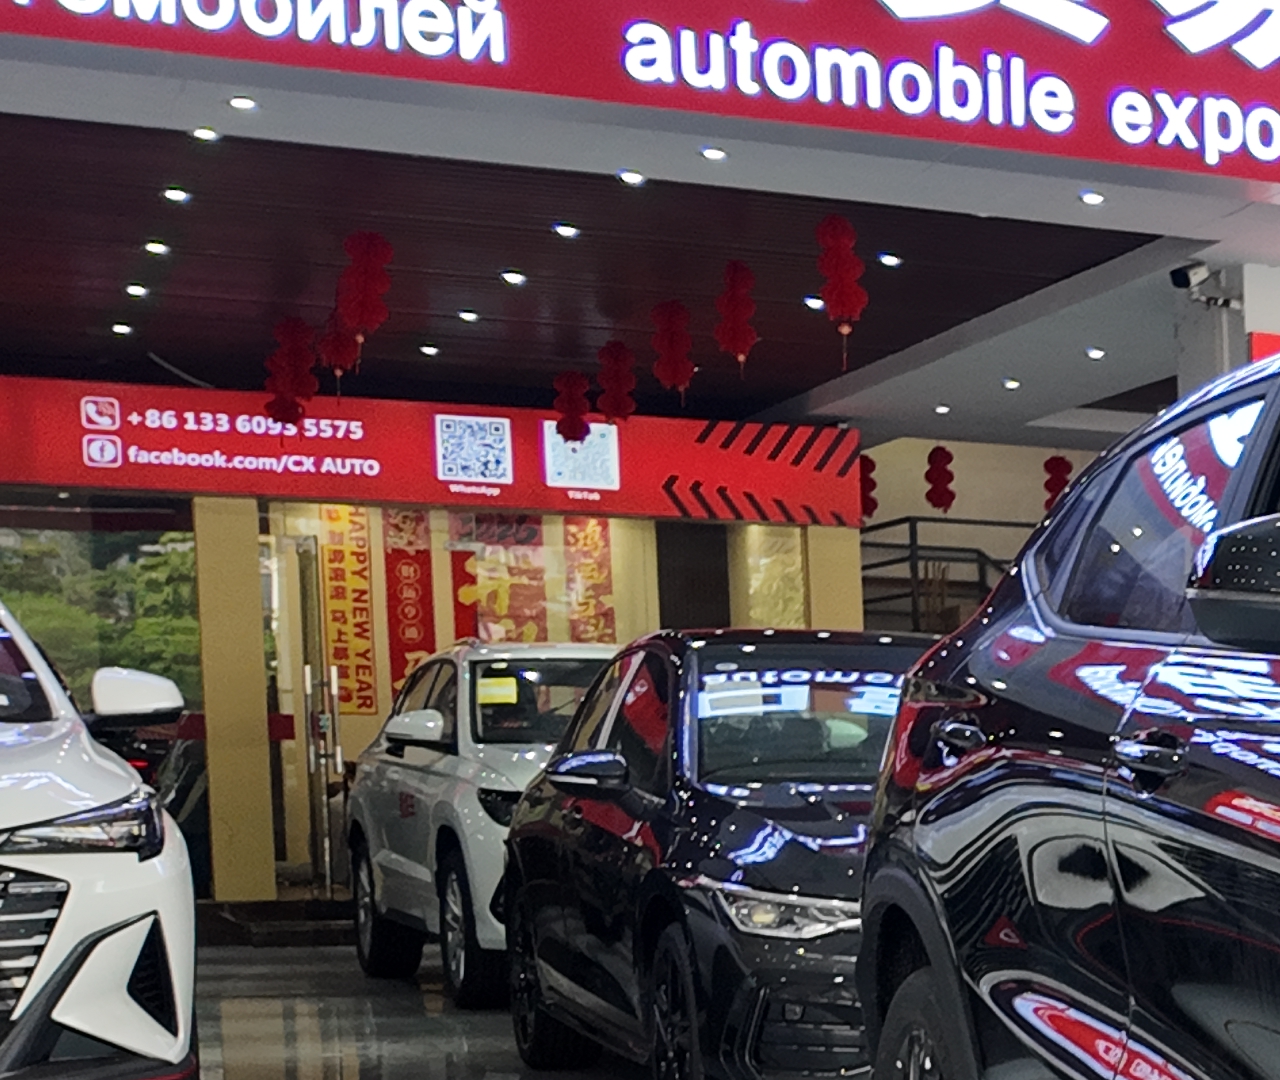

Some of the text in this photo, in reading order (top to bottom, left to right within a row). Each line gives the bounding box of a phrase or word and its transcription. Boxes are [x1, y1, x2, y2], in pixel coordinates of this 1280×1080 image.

[622, 18, 1076, 133] automobile
[126, 408, 177, 430] +86
[183, 411, 230, 433] 133
[303, 418, 364, 440] 5575
[126, 445, 381, 477] facebook.com/CX AUTO
[350, 588, 372, 642] NEW
[354, 648, 374, 710] YEAR
